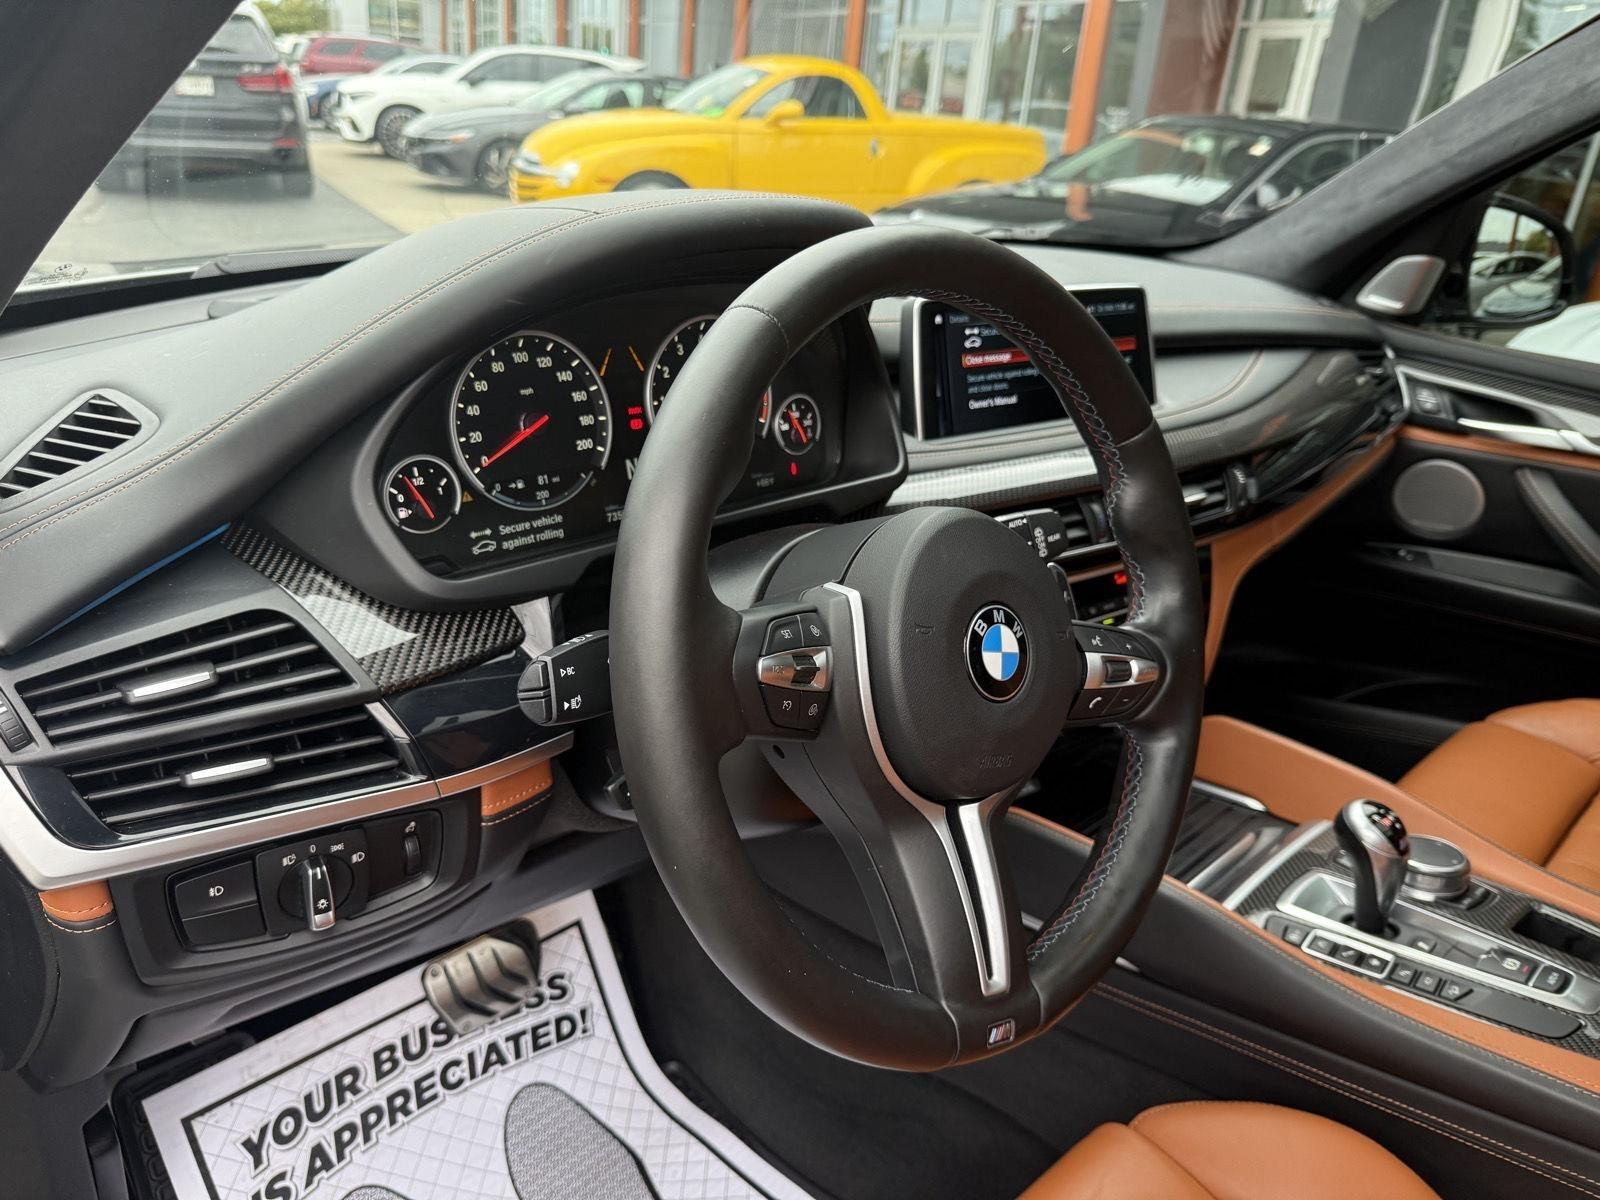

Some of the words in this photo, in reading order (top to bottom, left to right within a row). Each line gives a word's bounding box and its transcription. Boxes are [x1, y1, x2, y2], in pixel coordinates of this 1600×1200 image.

[677, 344, 685, 356] 3
[512, 352, 529, 364] 100
[536, 357, 552, 369] 120
[491, 362, 505, 373] 80
[662, 366, 671, 379] 2
[556, 371, 573, 382] 140
[474, 381, 488, 392] 60
[520, 386, 534, 396] mph
[571, 391, 588, 402] 160
[968, 398, 994, 410] Owner's
[994, 394, 1019, 406] Manual
[466, 405, 480, 417] 40
[579, 415, 595, 426] 180
[469, 431, 482, 443] 20
[576, 438, 594, 451] 200
[481, 455, 489, 466] 0
[412, 477, 425, 487] 1/2
[538, 474, 549, 486] 81
[495, 483, 501, 492] 0
[397, 494, 405, 503] 0
[536, 490, 550, 500] 200
[499, 522, 531, 535] Secure
[531, 514, 563, 529] vehicle
[502, 534, 535, 550] against
[536, 528, 564, 542] rolling
[974, 609, 1024, 639] BMW
[566, 666, 576, 675] BC
[310, 844, 316, 853] 0
[241, 1065, 365, 1171] YOUR
[373, 973, 569, 1082] BUSSS
[304, 1008, 589, 1191] APPRECIATED!
